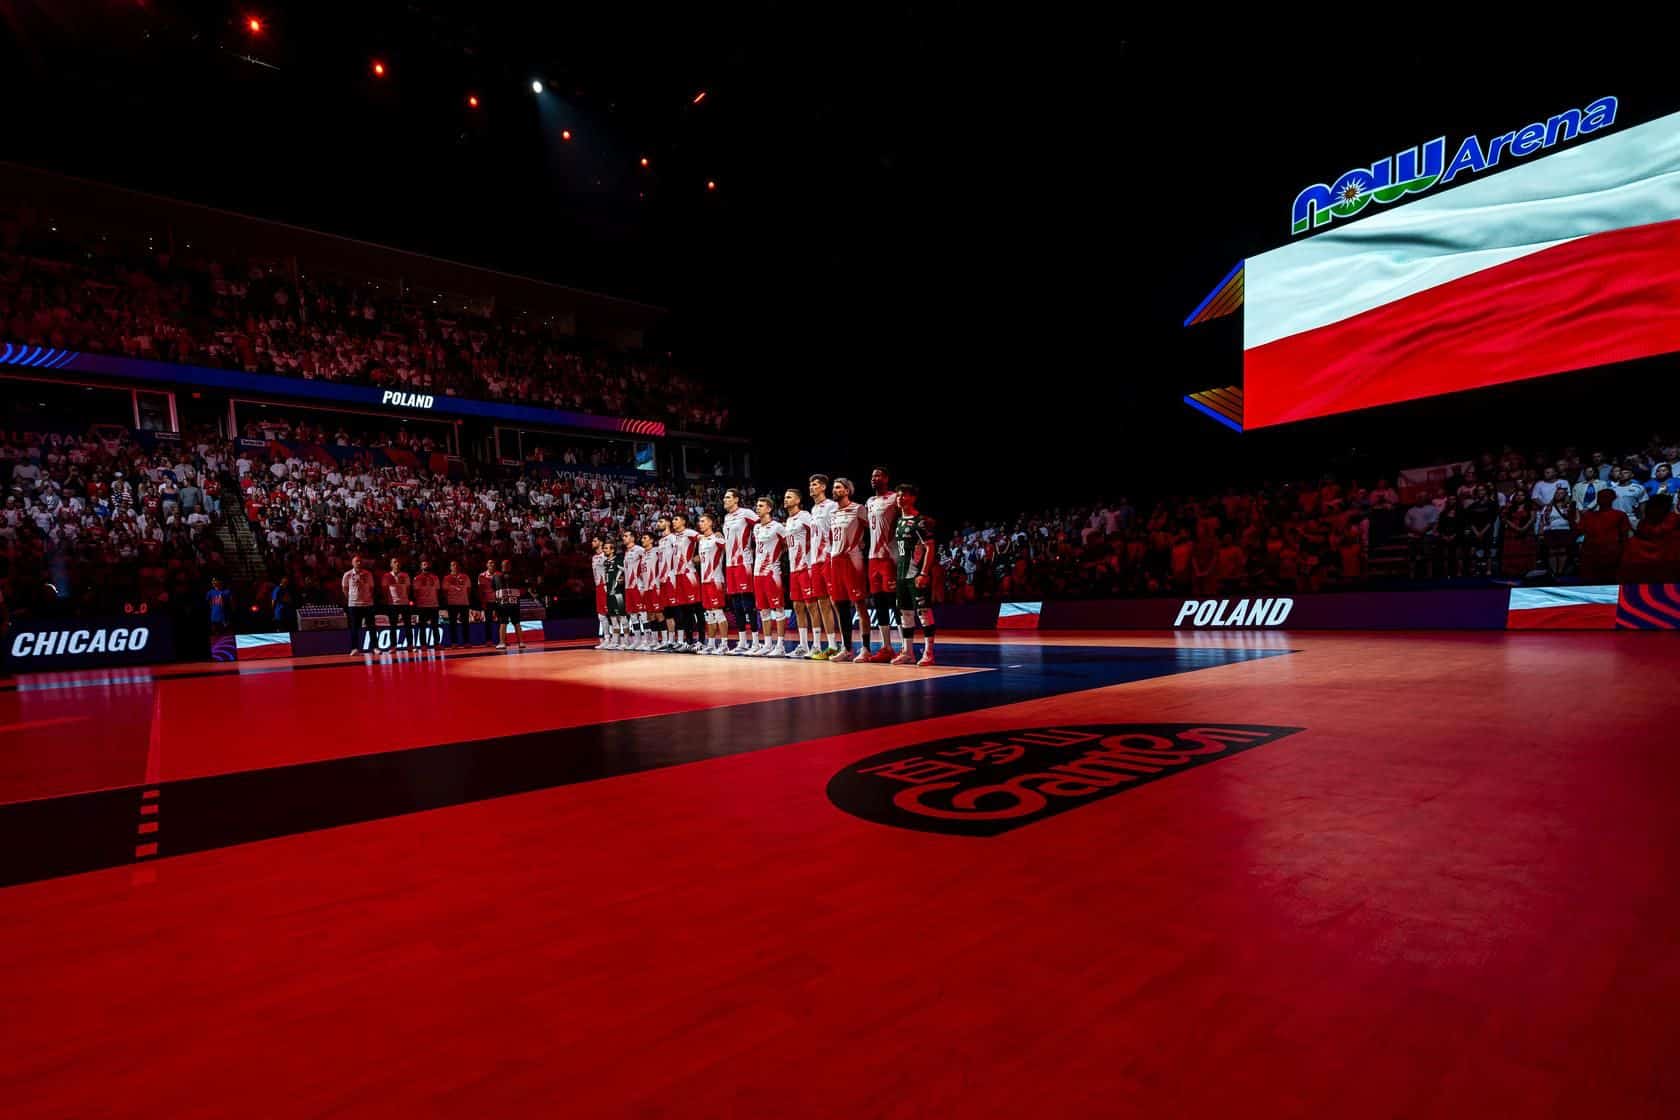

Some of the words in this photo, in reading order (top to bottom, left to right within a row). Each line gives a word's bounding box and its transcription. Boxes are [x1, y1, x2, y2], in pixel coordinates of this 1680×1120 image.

[1441, 96, 1619, 184] Arena
[382, 390, 434, 409] POLAND
[1173, 598, 1294, 627] POLAND
[11, 627, 150, 657] CHICAGO
